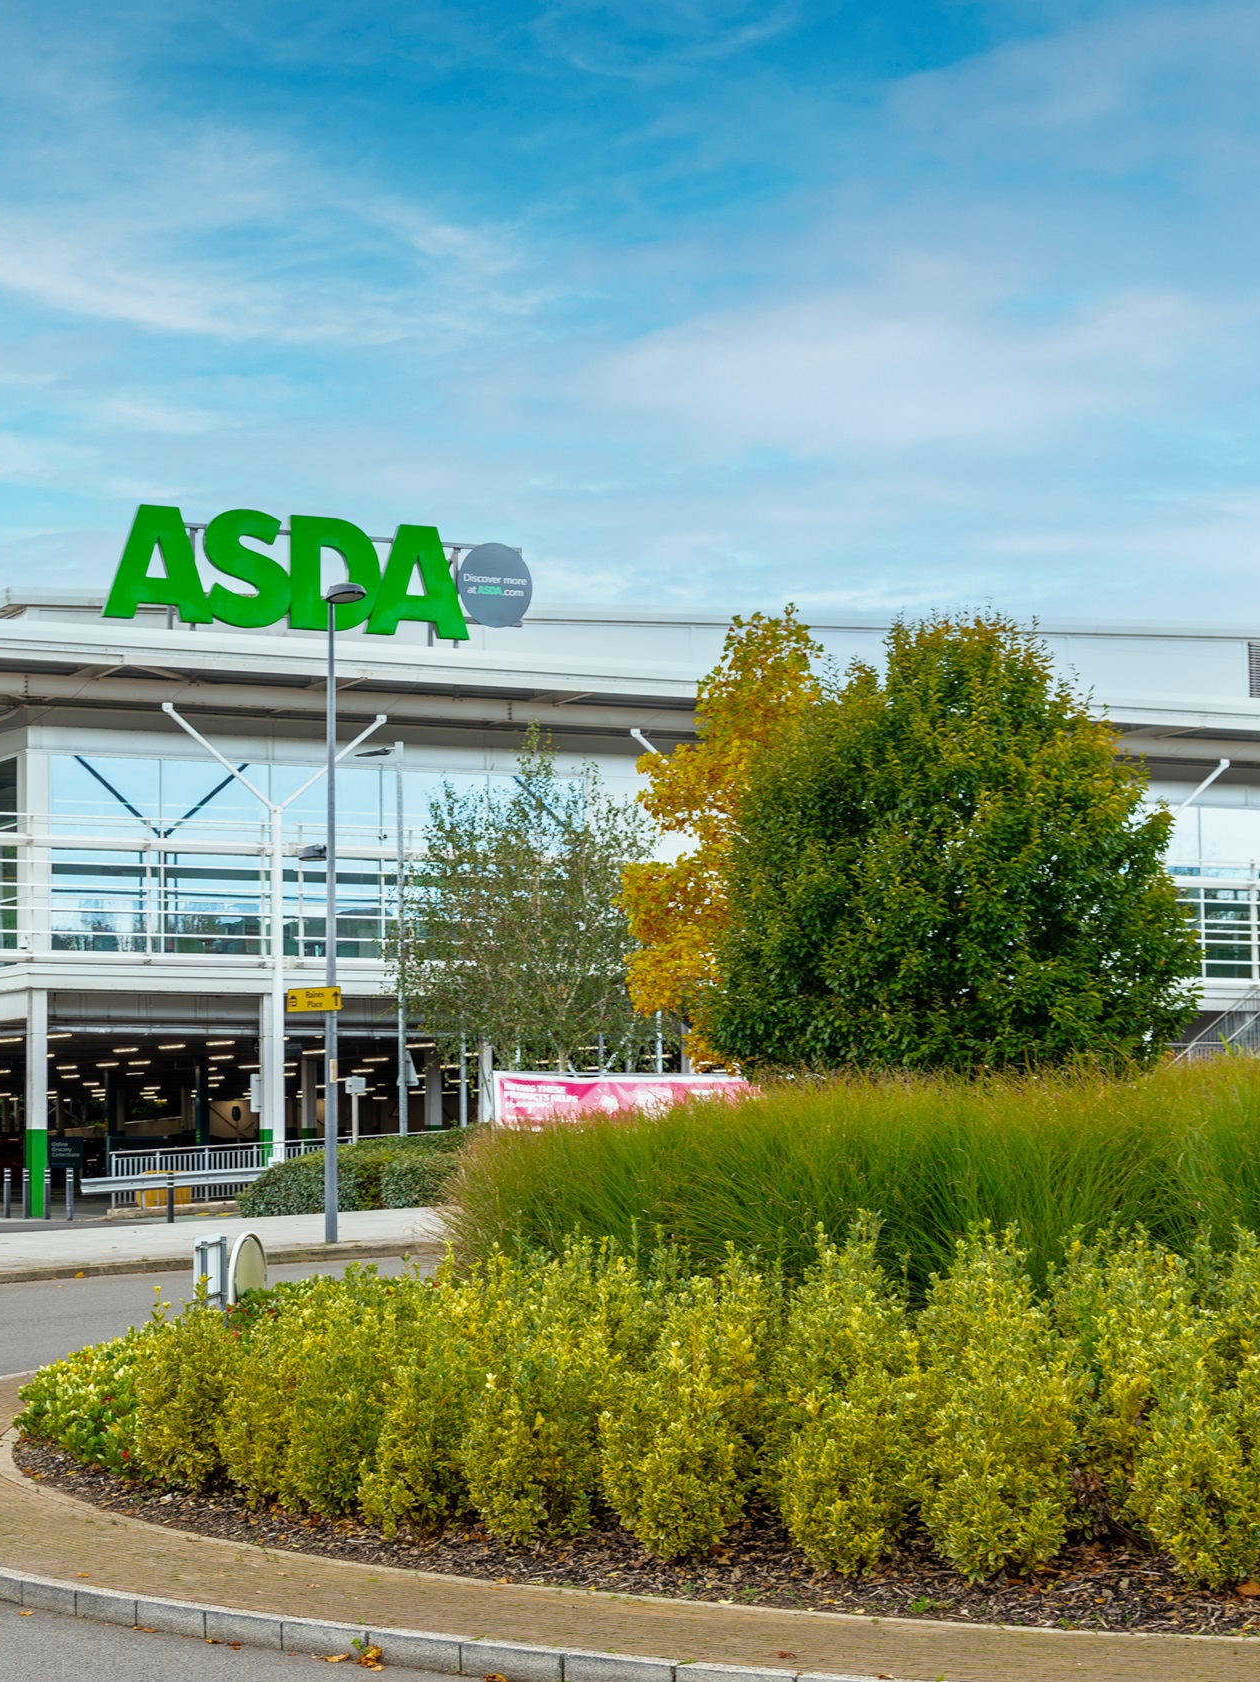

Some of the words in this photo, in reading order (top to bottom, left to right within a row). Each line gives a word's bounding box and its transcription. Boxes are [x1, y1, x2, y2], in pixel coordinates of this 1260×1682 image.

[101, 503, 470, 641] ASDA
[463, 573, 502, 584] Discover
[503, 577, 528, 586] more
[467, 586, 477, 594] at
[477, 585, 525, 597] ASDA.com
[305, 991, 325, 999] Raines
[537, 1085, 567, 1094] THESE
[551, 1094, 579, 1103] HELPS
